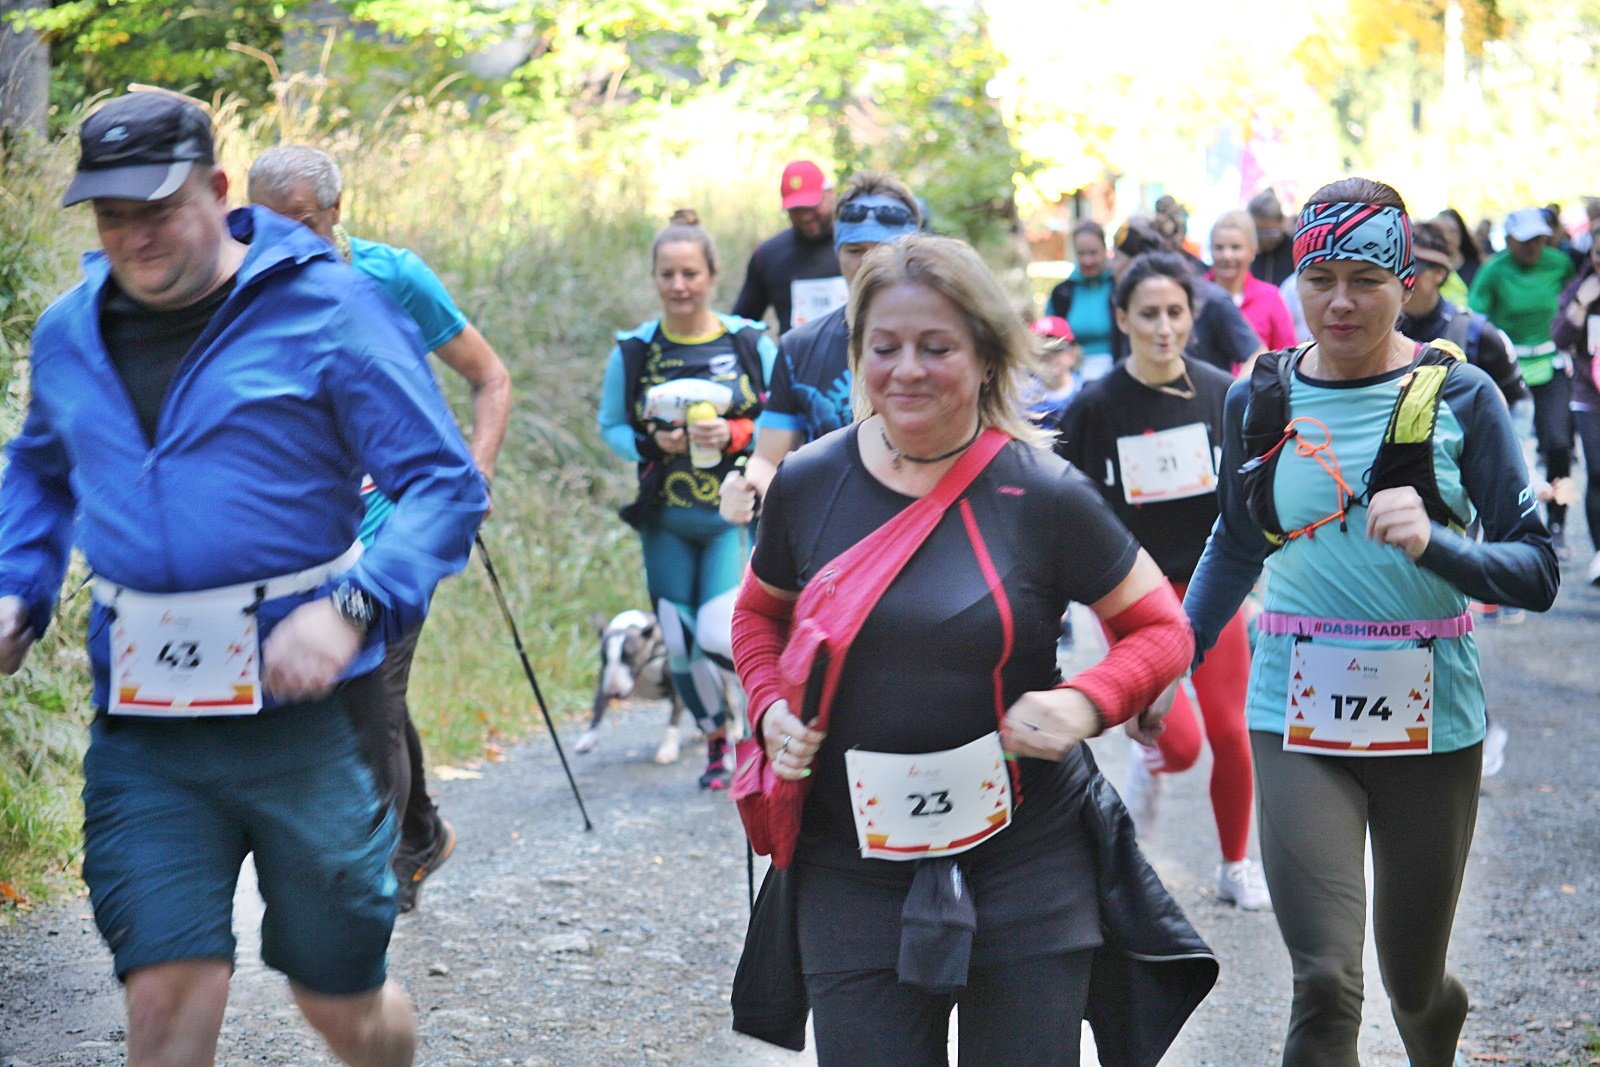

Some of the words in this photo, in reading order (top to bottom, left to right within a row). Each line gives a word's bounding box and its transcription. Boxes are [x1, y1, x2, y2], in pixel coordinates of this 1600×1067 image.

[1158, 455, 1177, 472] 21
[1313, 621, 1412, 637] #DASHRADE
[156, 640, 201, 668] 43
[1330, 693, 1393, 721] 174
[906, 789, 953, 817] 23
